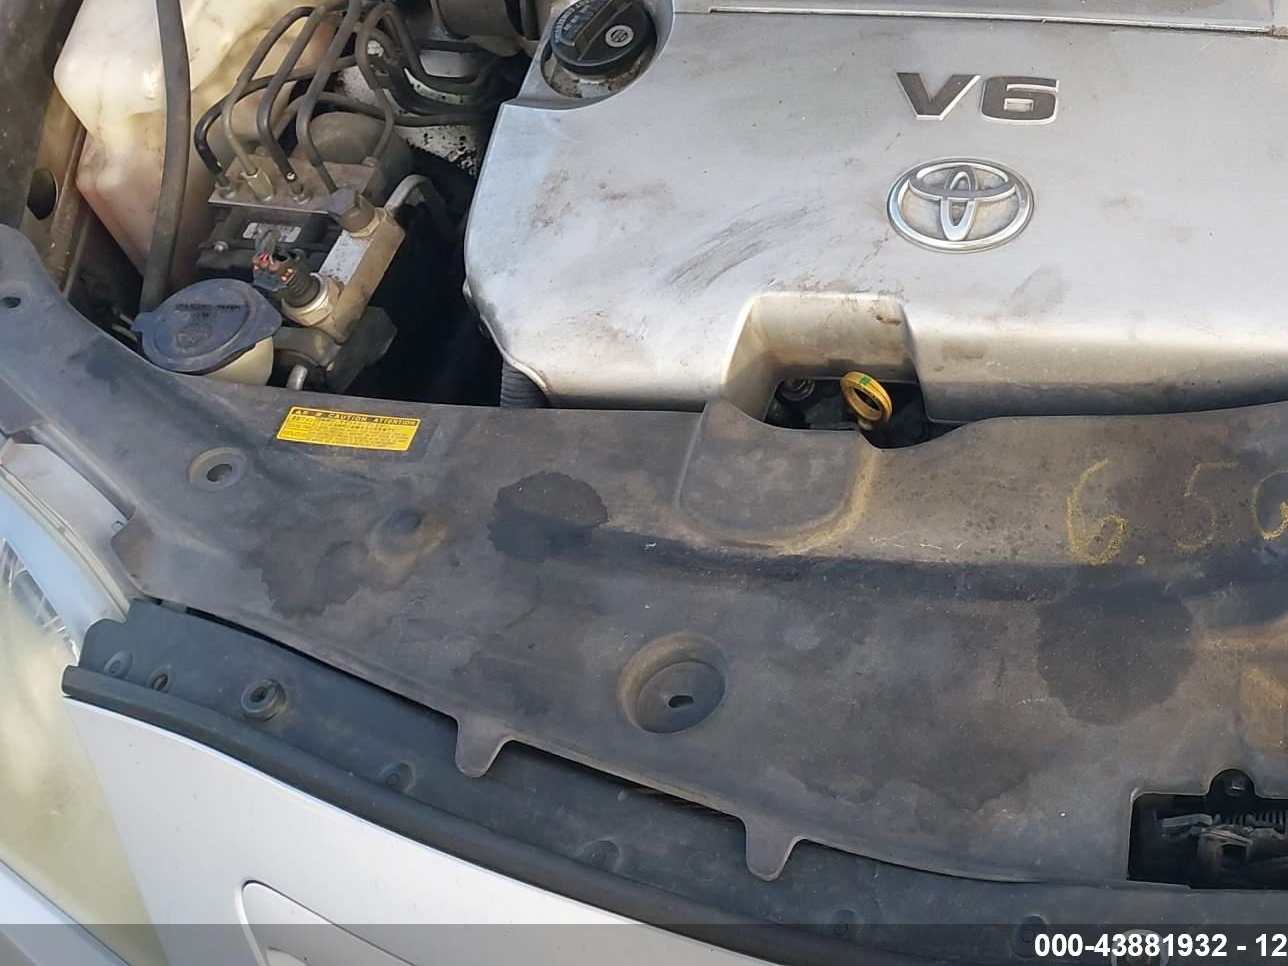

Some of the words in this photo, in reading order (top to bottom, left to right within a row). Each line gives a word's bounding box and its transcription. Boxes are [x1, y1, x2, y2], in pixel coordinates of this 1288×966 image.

[896, 71, 1061, 126] V6
[328, 412, 368, 423] CAUTION
[374, 417, 417, 427] ATTENTION
